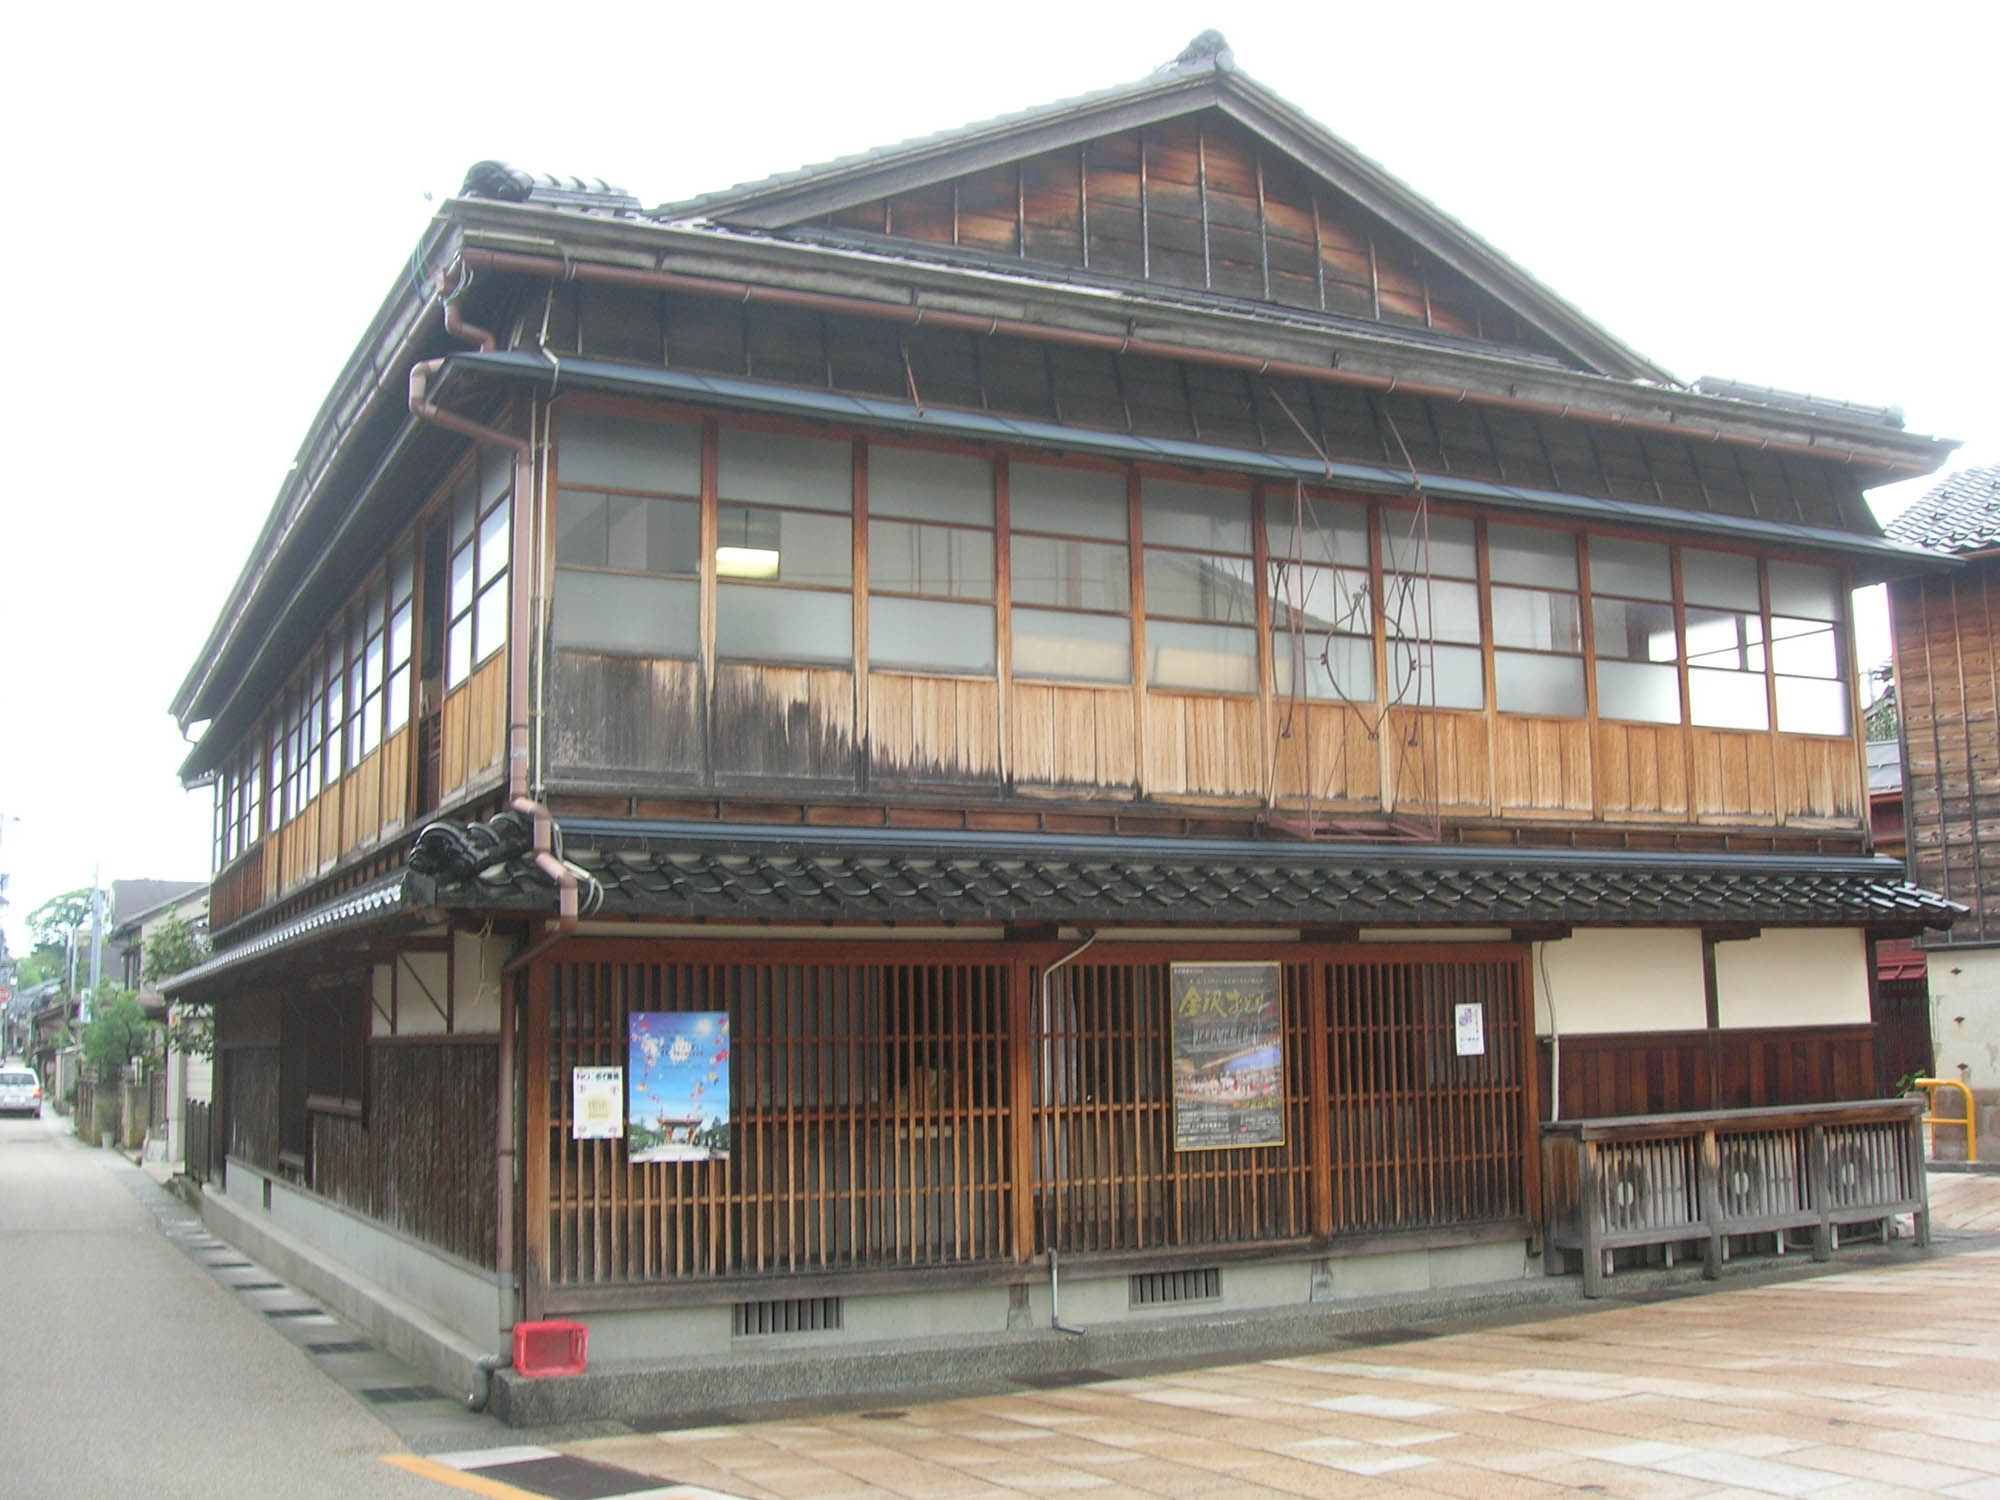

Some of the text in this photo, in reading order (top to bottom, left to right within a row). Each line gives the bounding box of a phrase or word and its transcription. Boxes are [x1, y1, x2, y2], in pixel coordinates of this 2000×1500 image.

[1179, 985, 1264, 1018] 金沢おどり
